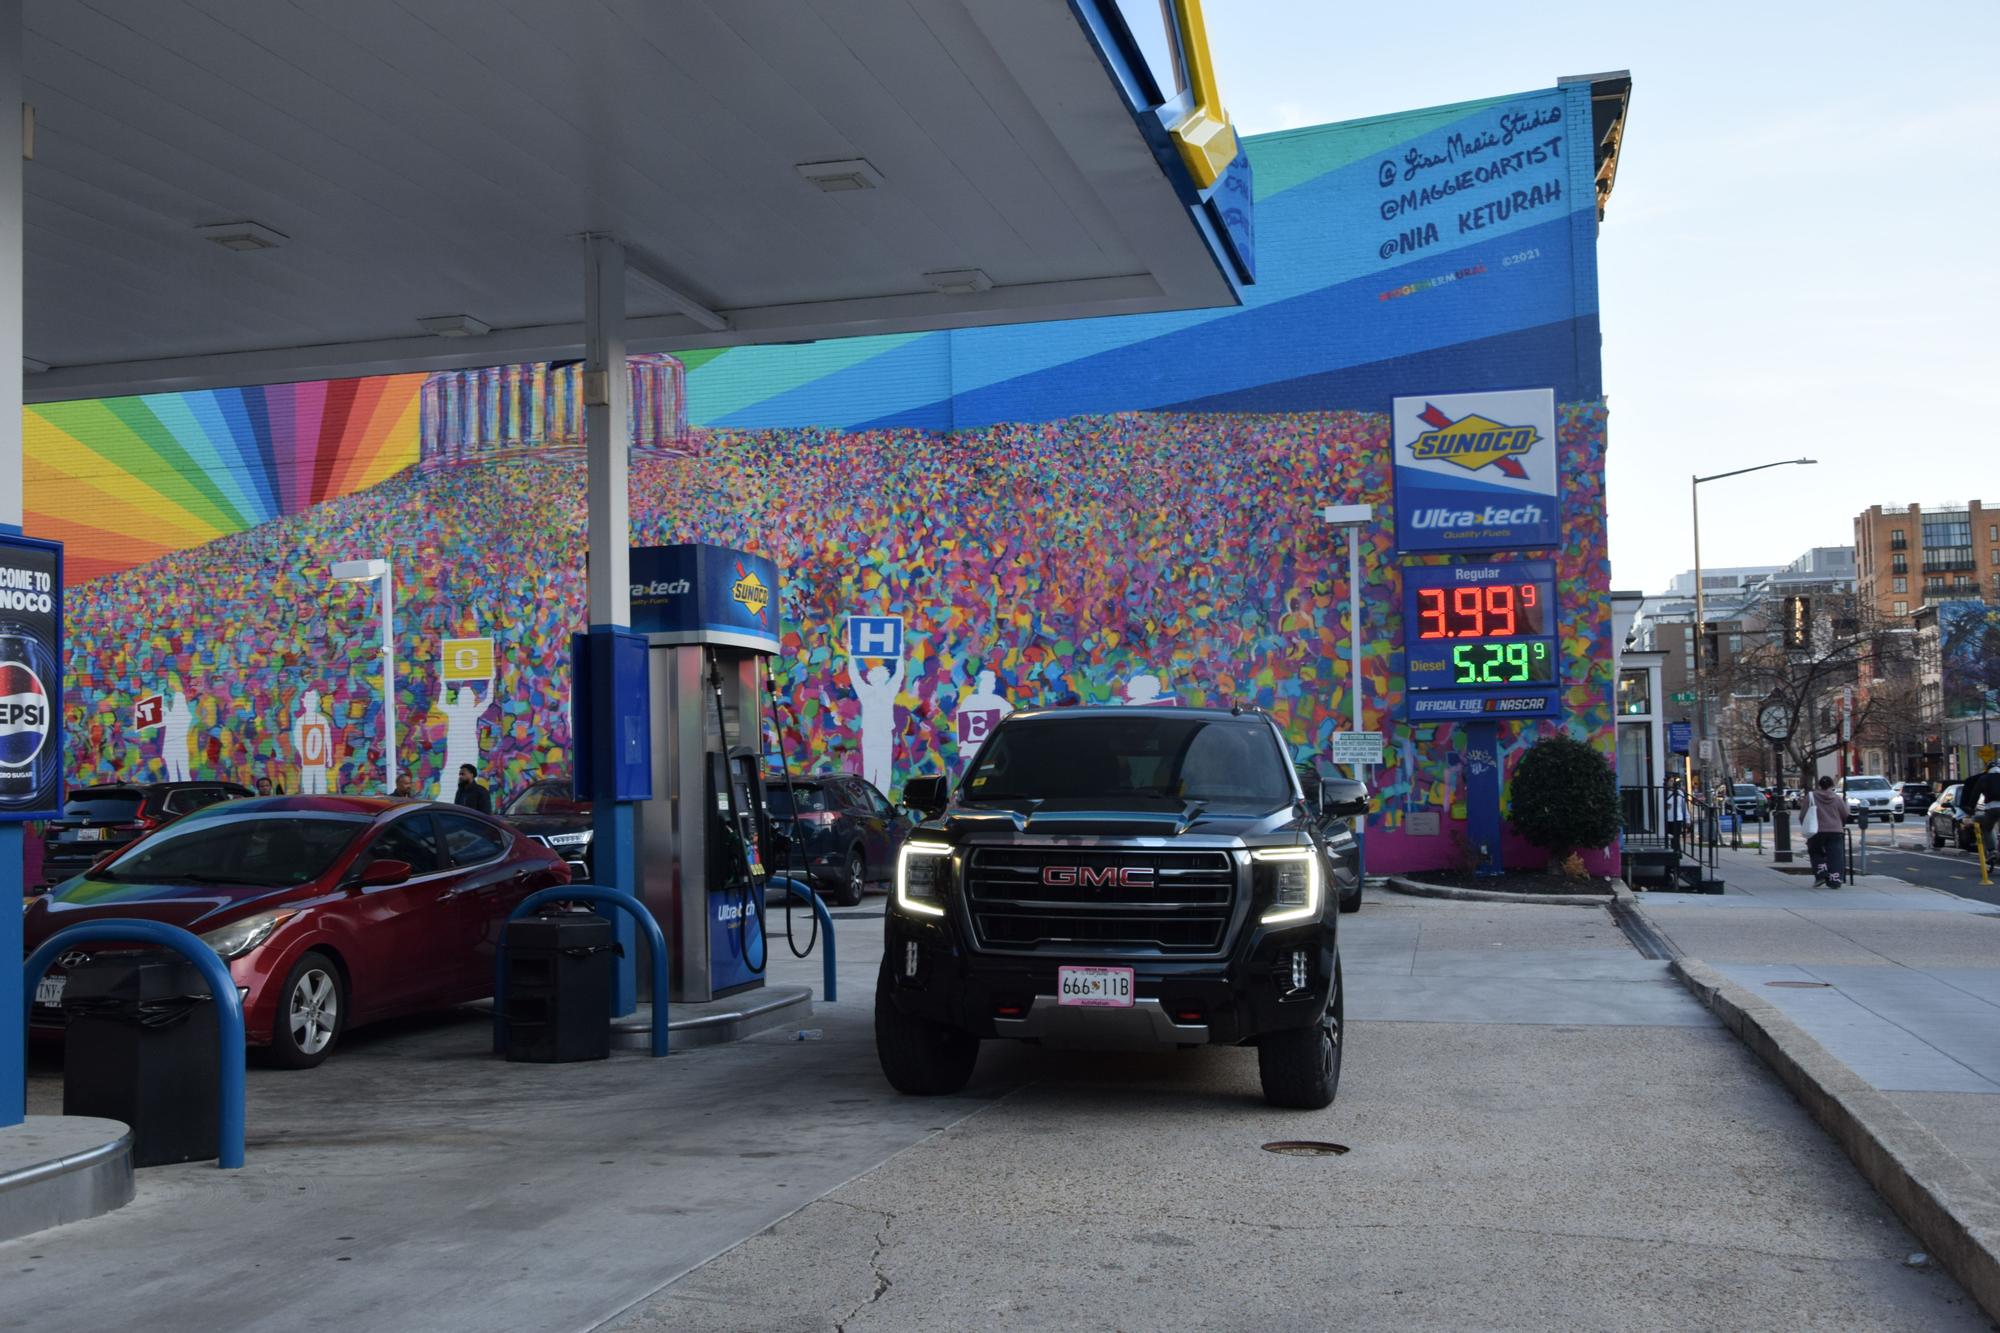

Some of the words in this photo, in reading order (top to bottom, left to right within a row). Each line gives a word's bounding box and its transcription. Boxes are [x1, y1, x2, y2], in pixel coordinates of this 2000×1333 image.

[1379, 223, 1439, 259] @NIA
[1458, 179, 1562, 234] KETURAH
[1418, 430, 1532, 455] SUNOCO
[34, 571, 51, 592] TO
[1455, 567, 1500, 581] Regular
[735, 583, 768, 605] SUNOCO
[859, 622, 894, 653] H
[455, 649, 479, 670] G
[1410, 660, 1446, 672] Diesel
[1416, 700, 1457, 712] OFFICIAL
[1460, 699, 1483, 710] FUEL
[1500, 698, 1545, 711] NASCAR
[967, 711, 989, 742] E
[1043, 866, 1155, 888] GMC
